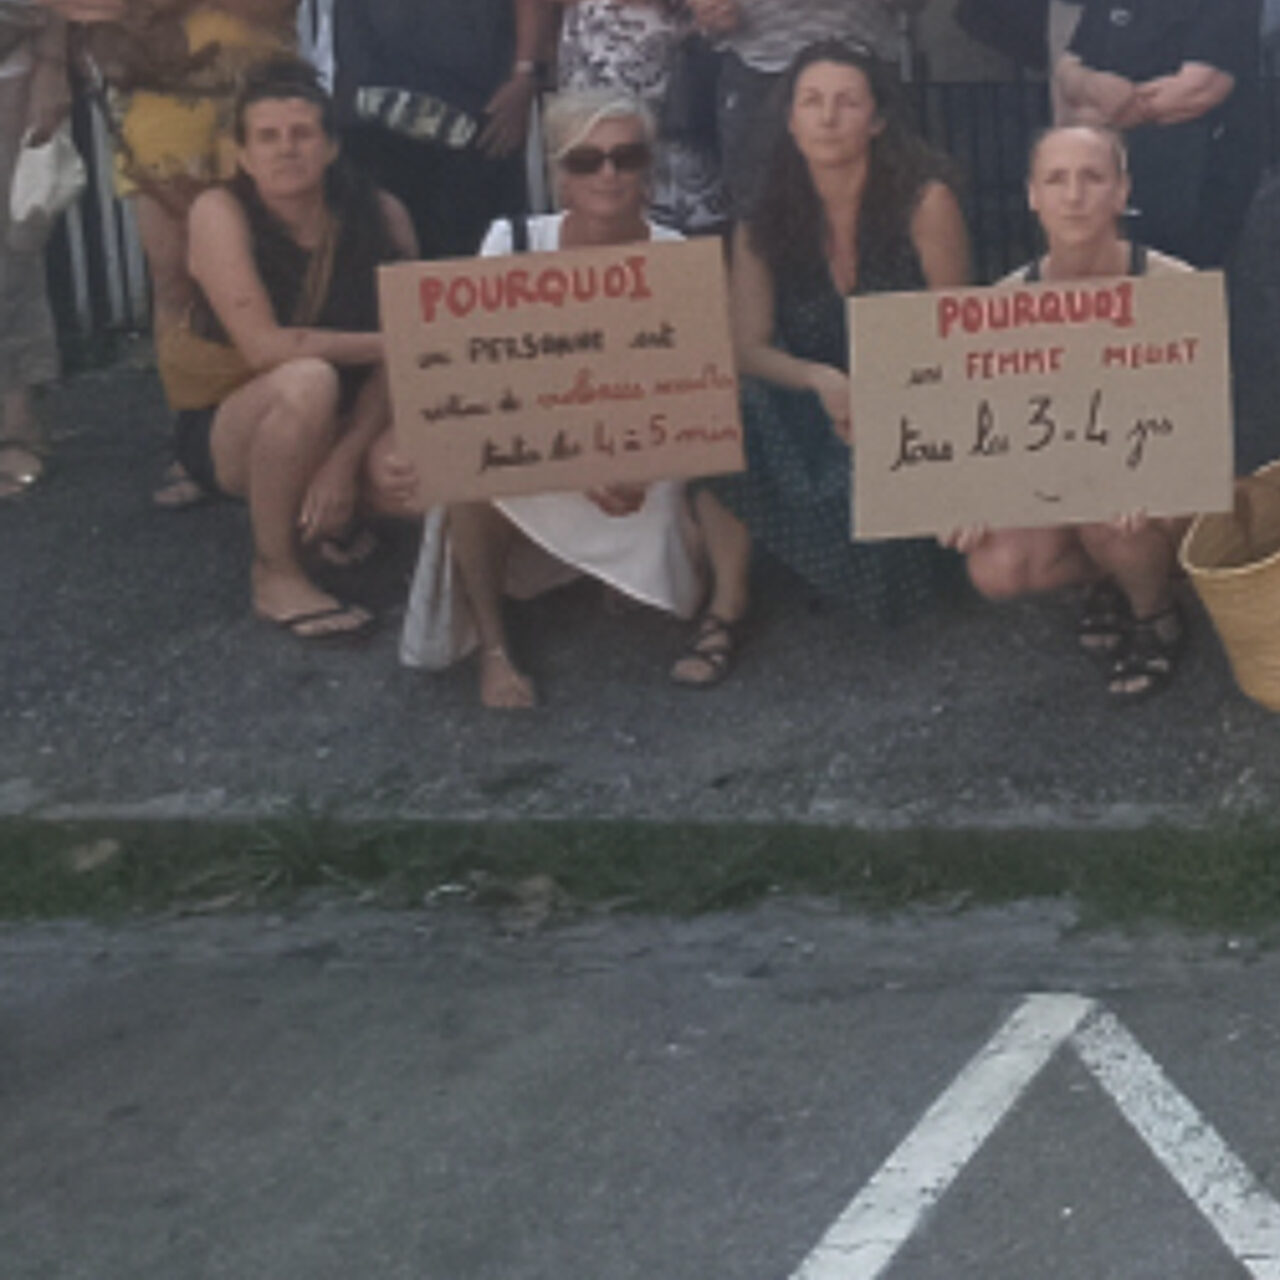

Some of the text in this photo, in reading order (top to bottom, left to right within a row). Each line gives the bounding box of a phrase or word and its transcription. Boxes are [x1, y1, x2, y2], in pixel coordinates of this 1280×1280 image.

[418, 256, 654, 322] POURQUOI
[937, 282, 1134, 338] POURQUOI
[965, 348, 1065, 380] FEMME
[1104, 338, 1199, 369] MEURT
[593, 421, 614, 456] 4
[649, 413, 666, 446] 5
[674, 416, 739, 443] min
[890, 415, 953, 472] tous
[969, 400, 1009, 456] les
